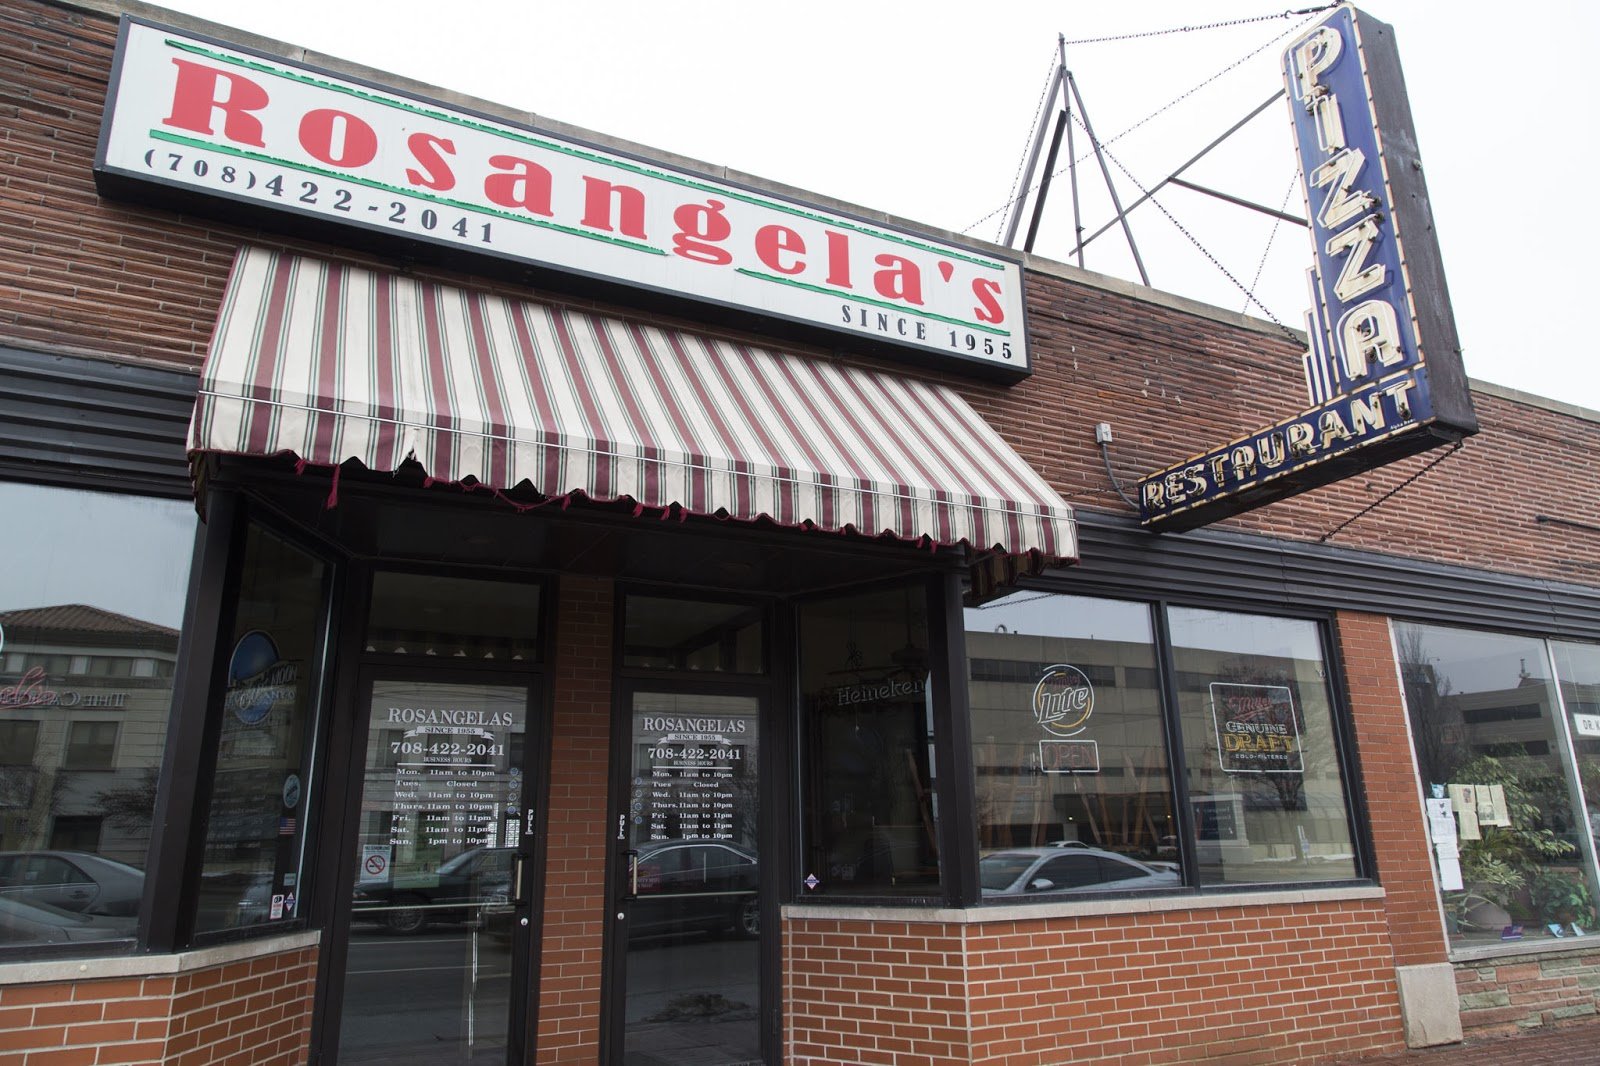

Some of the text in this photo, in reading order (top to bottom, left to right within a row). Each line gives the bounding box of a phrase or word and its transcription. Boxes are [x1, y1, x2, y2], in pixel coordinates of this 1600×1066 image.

[143, 148, 494, 245] (708)422-2041
[161, 57, 1006, 326] Rosangela's
[1289, 25, 1404, 380] PIZZA
[841, 304, 1014, 361] SINCE 1955
[1141, 380, 1416, 512] RESTAURANT
[837, 679, 925, 706] Heineken
[388, 708, 512, 726] ROSANGELAS
[643, 717, 745, 733] ROSANGELAS
[1225, 721, 1288, 734] GENUINE
[391, 742, 504, 756] 708-422-2041
[648, 748, 740, 760] 708-422-2041
[1224, 733, 1293, 753] DRAFT
[1043, 744, 1096, 768] OPEN
[470, 792, 493, 800] 10pm
